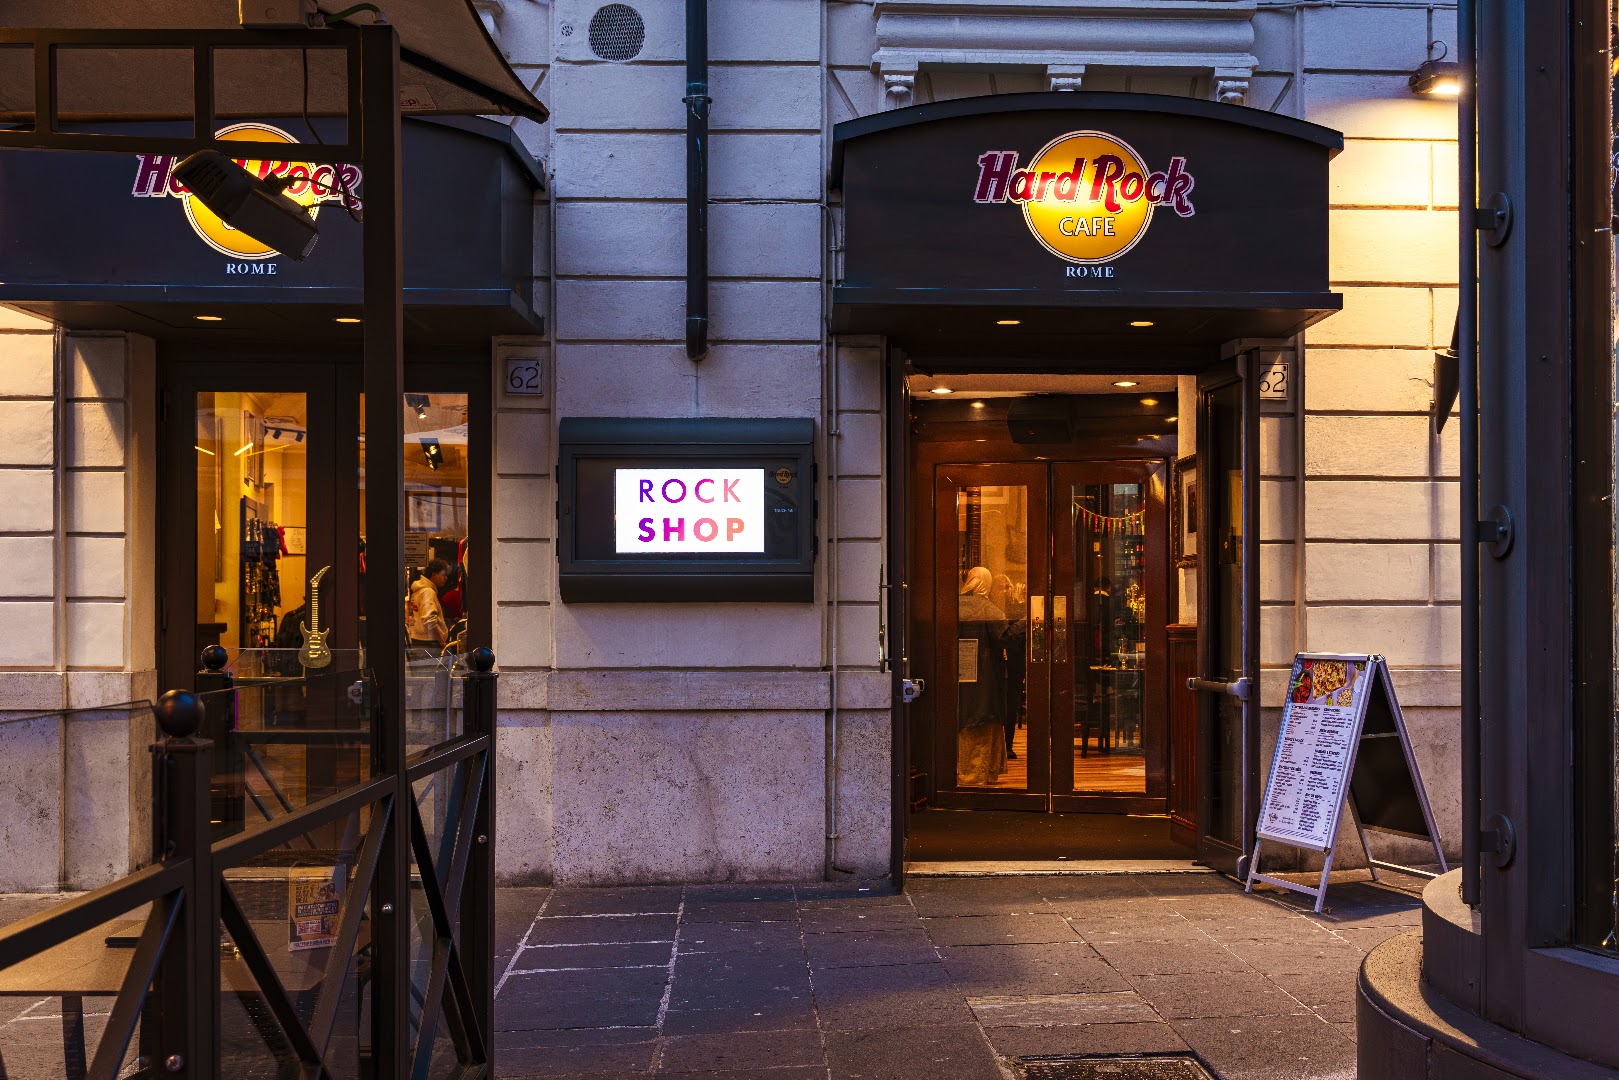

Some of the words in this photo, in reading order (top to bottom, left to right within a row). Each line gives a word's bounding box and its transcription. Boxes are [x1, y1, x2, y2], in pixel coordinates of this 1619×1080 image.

[974, 150, 1087, 204] Hard
[1090, 153, 1195, 217] Rock
[1059, 216, 1116, 237] CAFE
[226, 263, 277, 275] ROME
[1065, 266, 1115, 278] ROME
[510, 366, 539, 389] 62
[1260, 370, 1286, 393] 62
[639, 478, 742, 504] ROCK
[637, 517, 745, 543] SHOP
